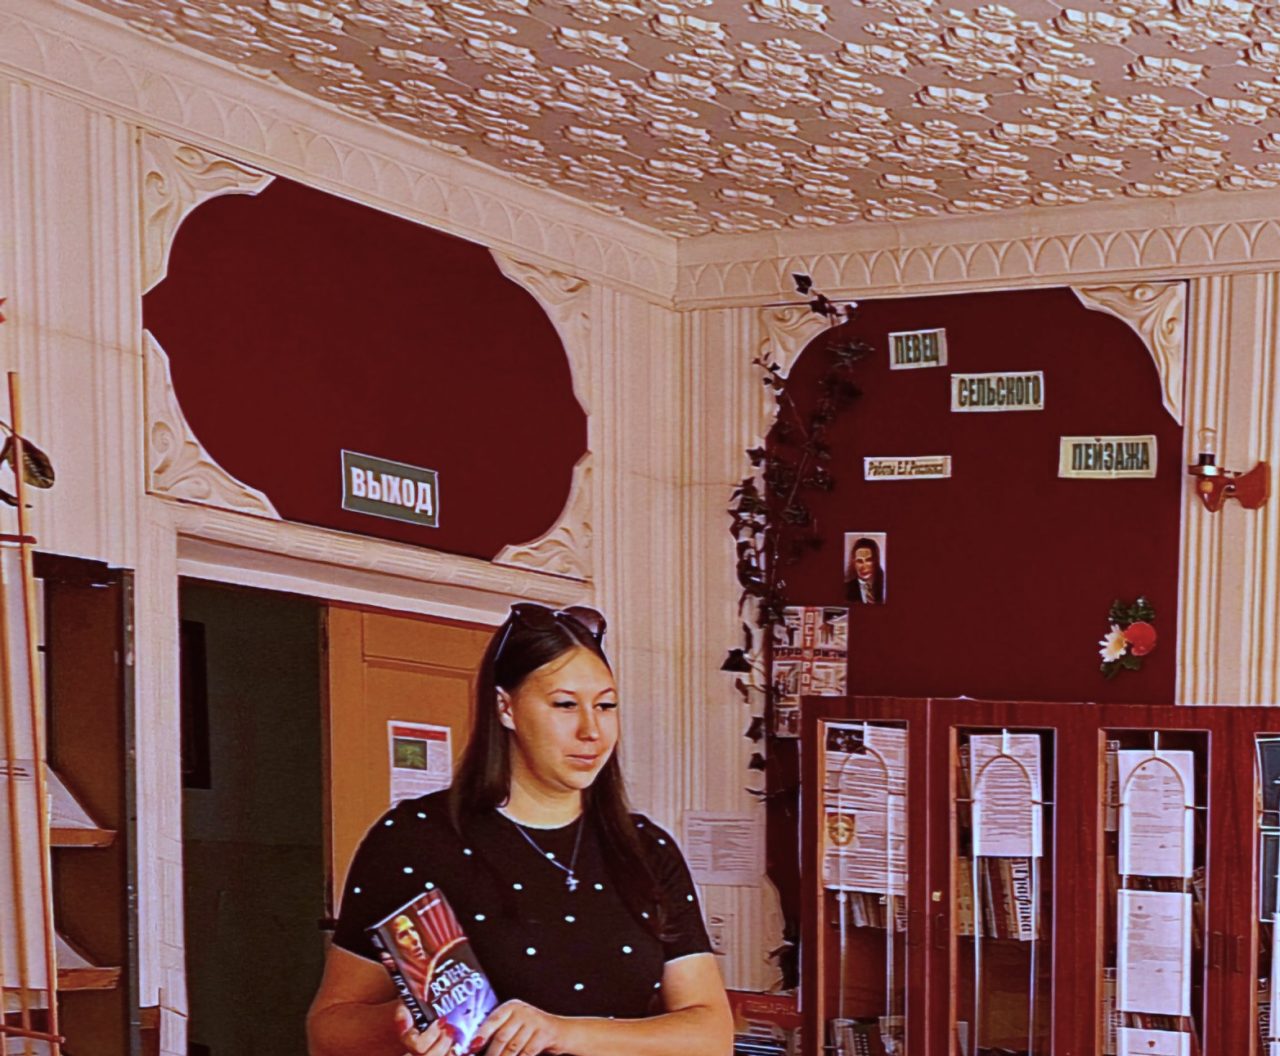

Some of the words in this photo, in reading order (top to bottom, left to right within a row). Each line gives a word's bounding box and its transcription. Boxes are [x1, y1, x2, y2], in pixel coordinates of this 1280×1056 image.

[893, 332, 940, 365] ПЕВЕЦ
[958, 375, 1041, 407] СЕЛЬСКОГО
[1071, 438, 1150, 471] ПЕЙЗАЖА
[350, 466, 433, 517] ВЫХОД
